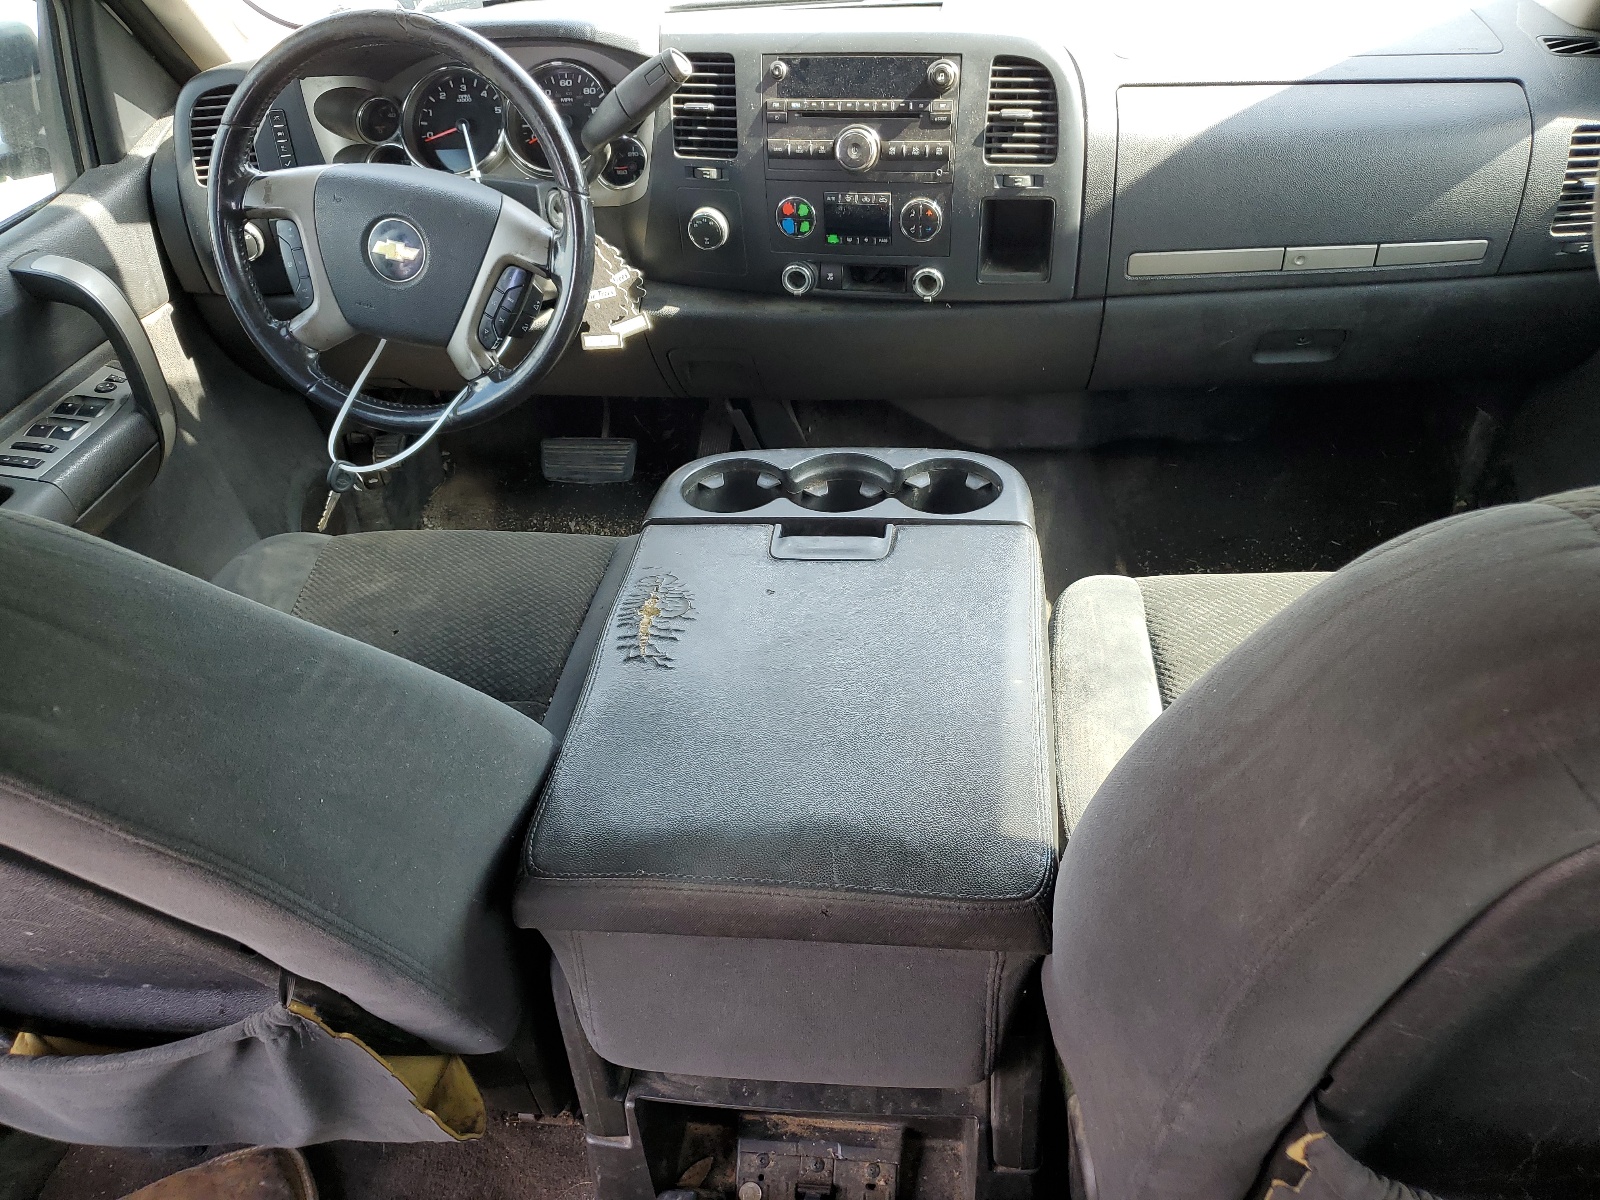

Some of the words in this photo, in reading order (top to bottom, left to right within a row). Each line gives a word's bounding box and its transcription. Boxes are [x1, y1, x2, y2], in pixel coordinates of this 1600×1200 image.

[559, 79, 573, 87] 60
[459, 84, 467, 92] 3
[583, 87, 596, 95] 80
[439, 92, 447, 100] 2
[480, 90, 488, 98] 4
[494, 106, 502, 114] 5
